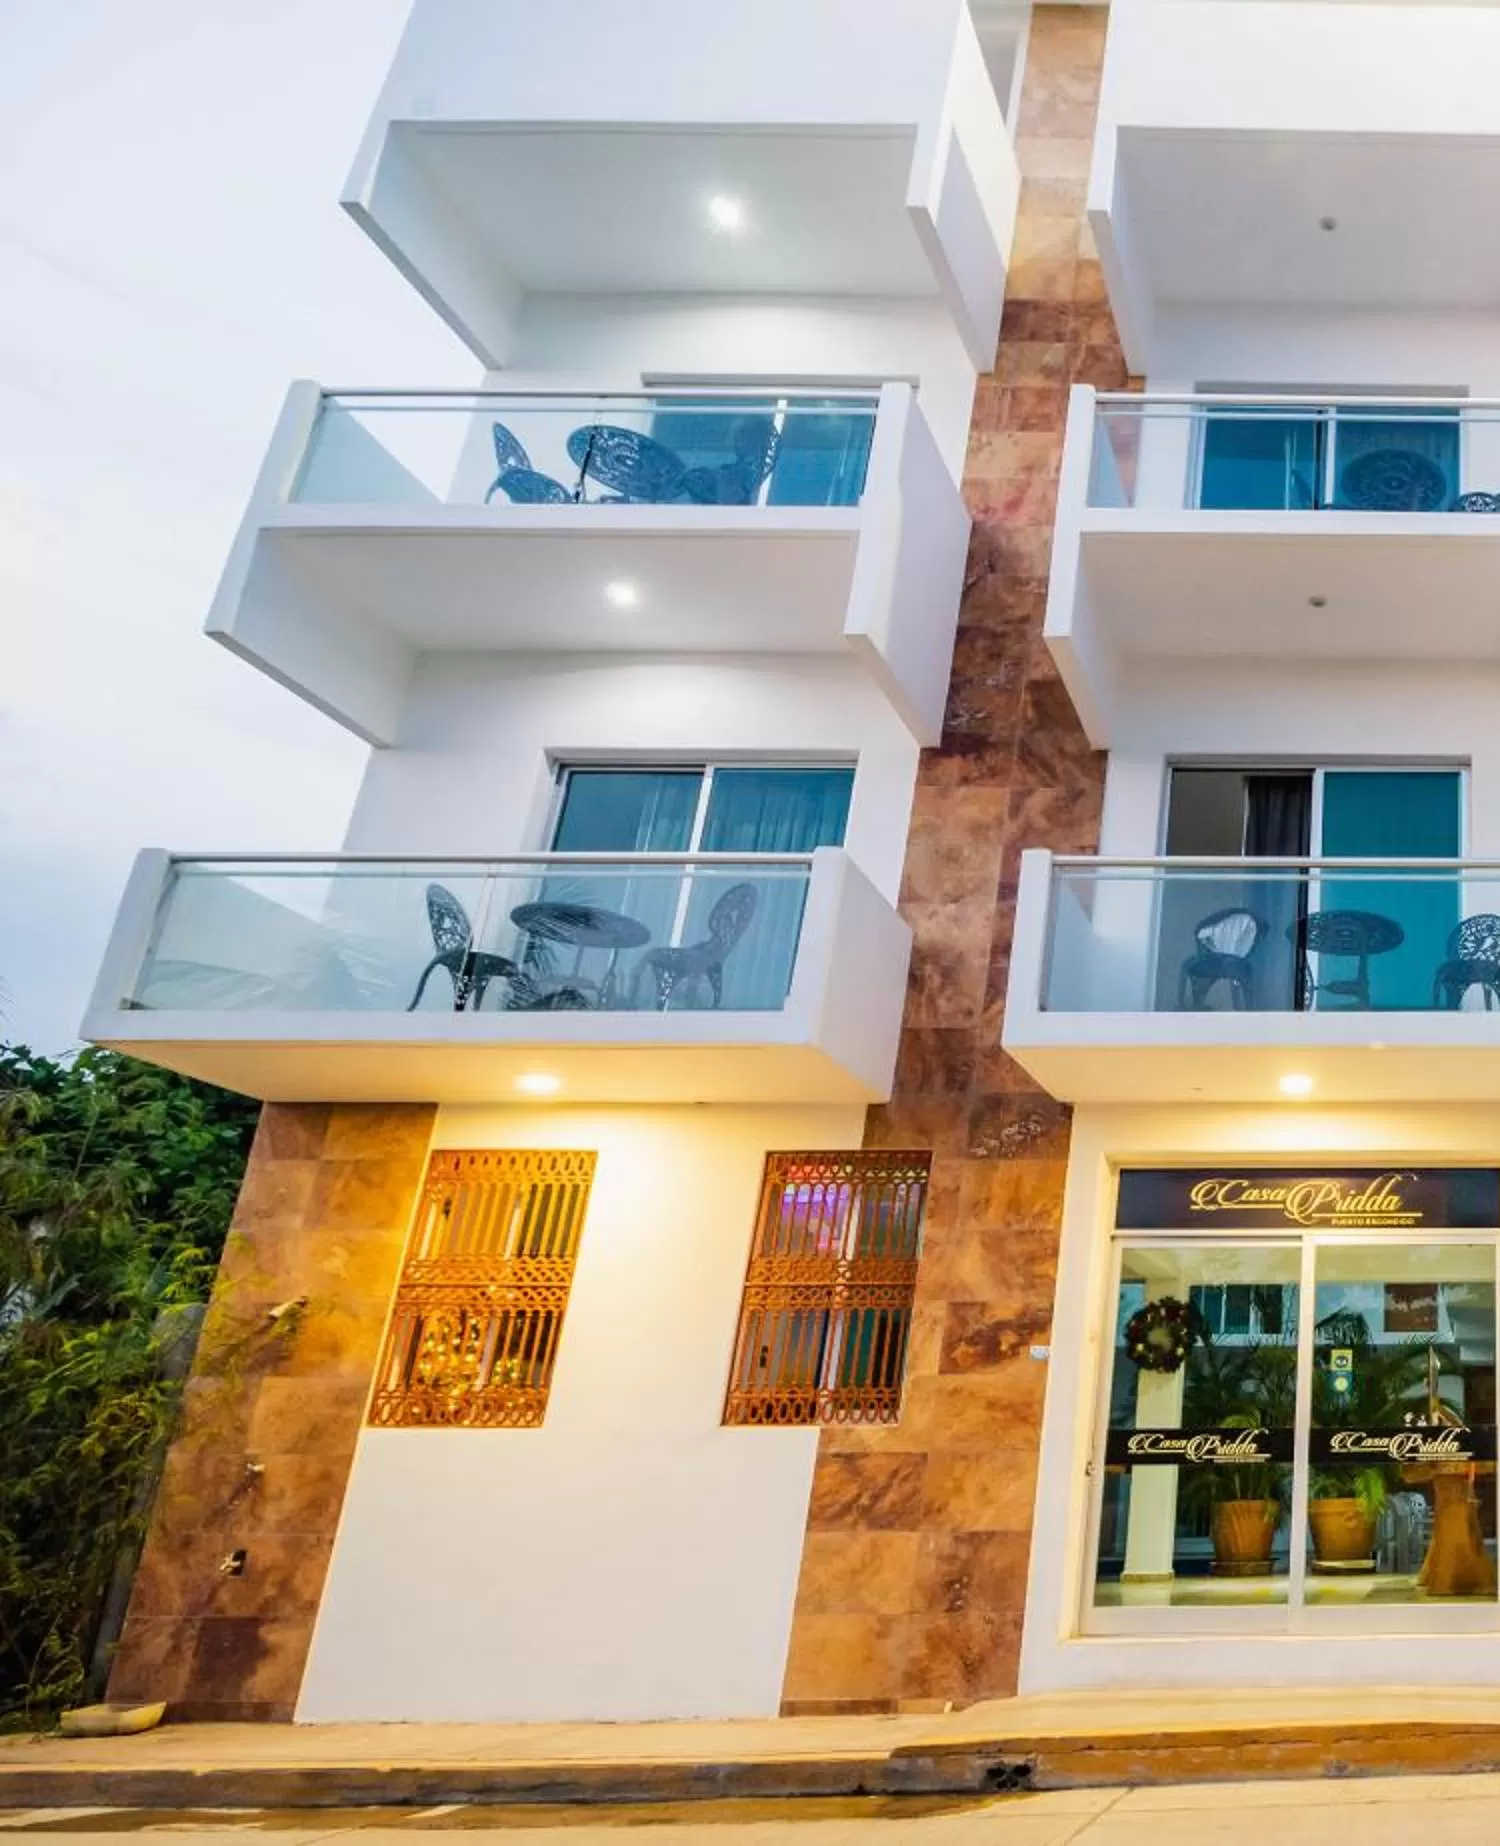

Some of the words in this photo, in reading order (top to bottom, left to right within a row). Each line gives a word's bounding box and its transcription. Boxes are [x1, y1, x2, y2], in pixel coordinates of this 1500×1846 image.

[1190, 1179, 1287, 1208] Casa
[1285, 1173, 1418, 1225] Pridda
[1128, 1433, 1187, 1453] Casa
[1330, 1431, 1389, 1452] Casa
